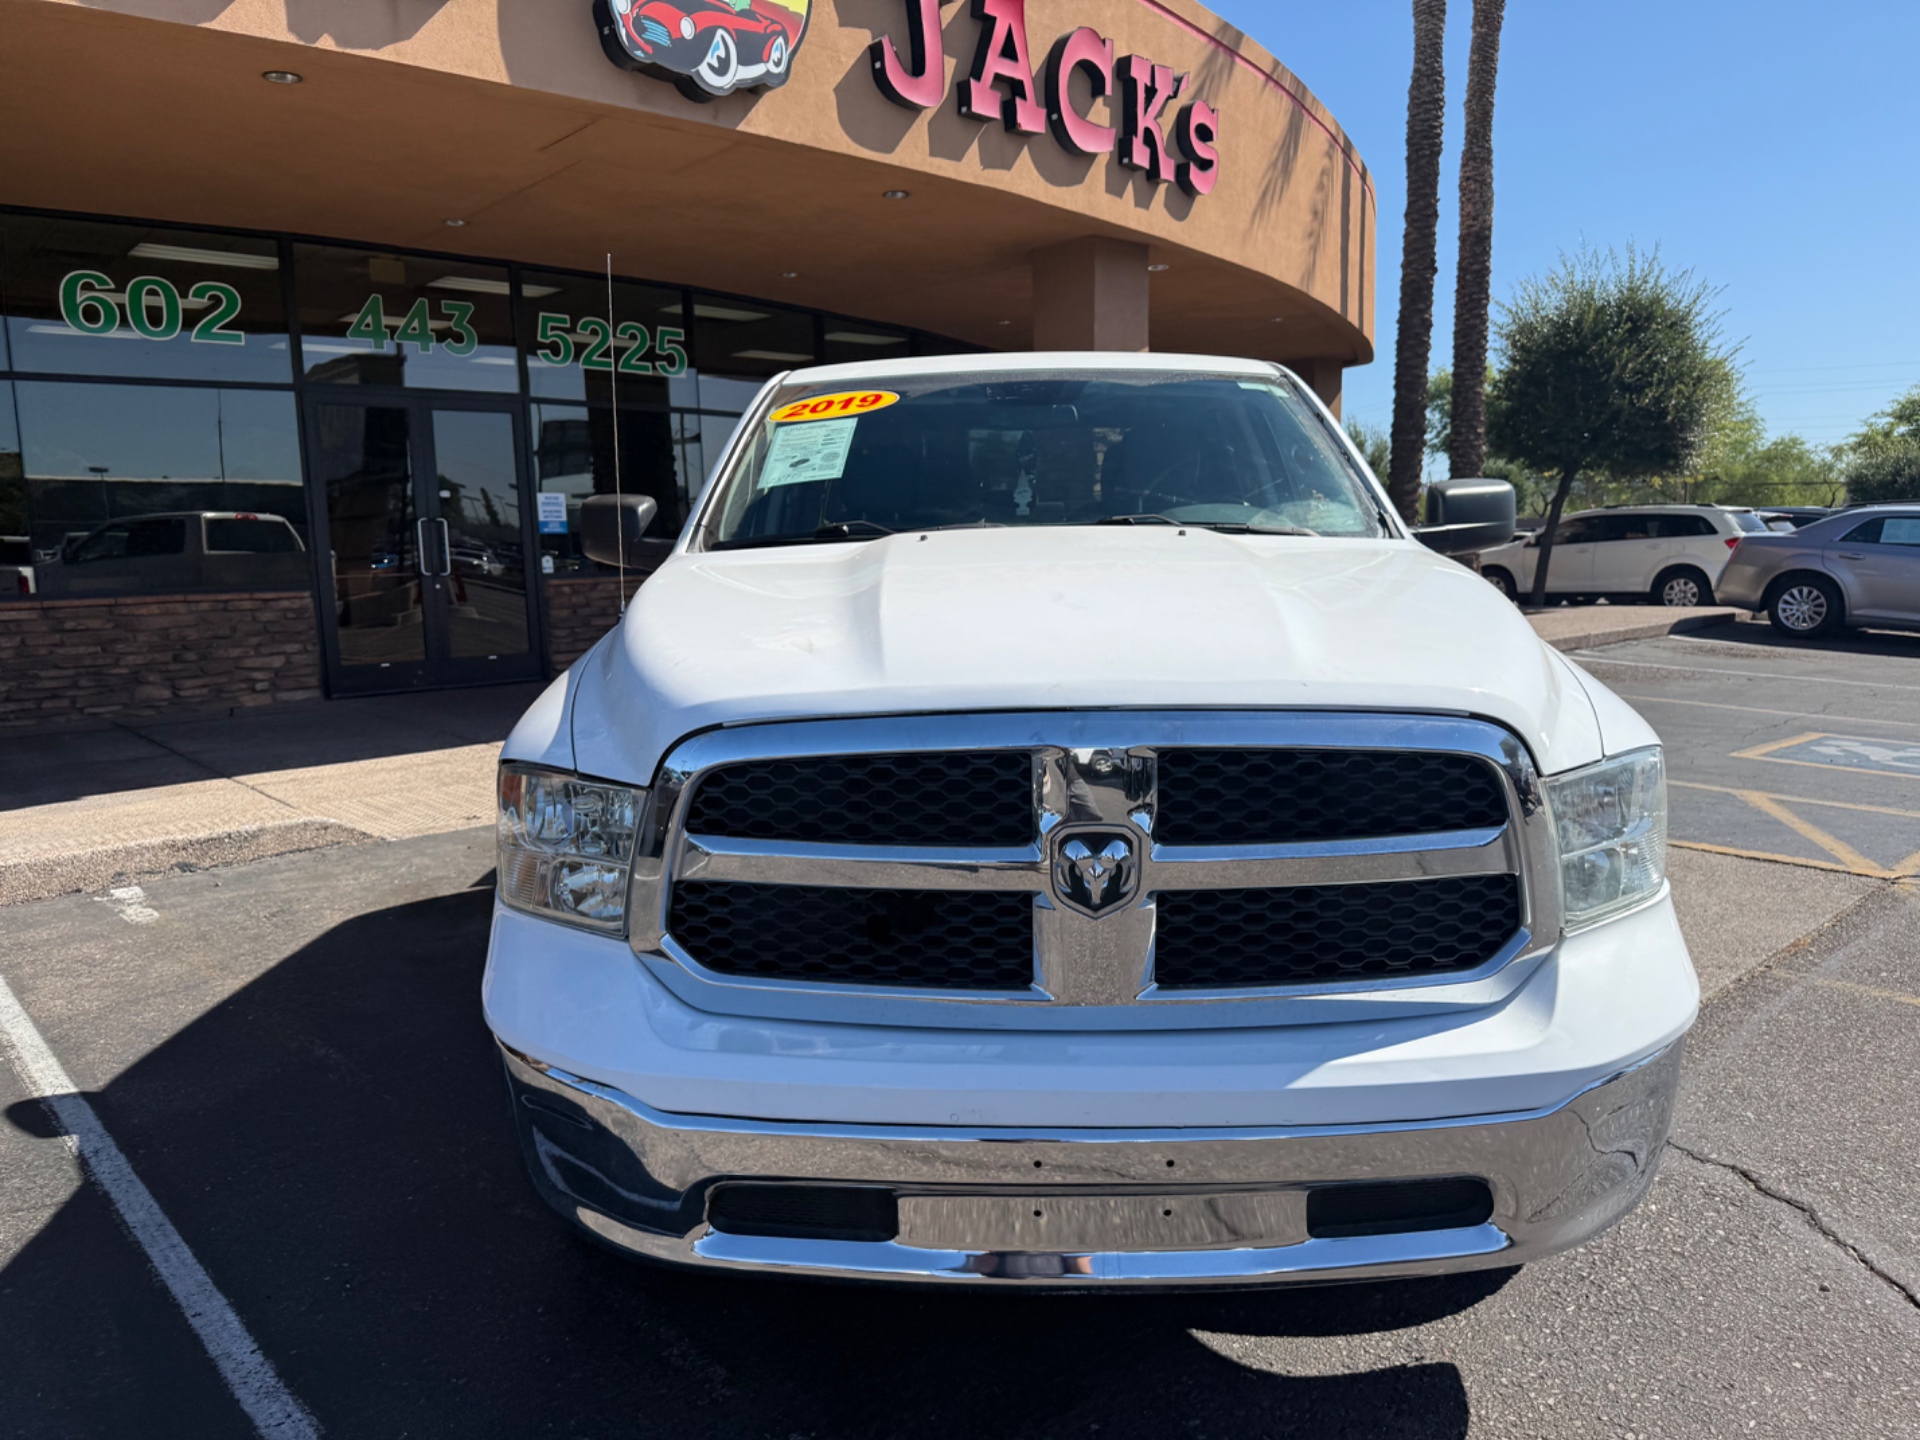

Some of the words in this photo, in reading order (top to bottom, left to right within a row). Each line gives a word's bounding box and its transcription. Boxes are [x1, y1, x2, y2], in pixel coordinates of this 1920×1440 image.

[59, 270, 245, 345] 602
[346, 293, 478, 357] 443
[536, 311, 688, 378] 5225
[781, 393, 883, 420] 2019
